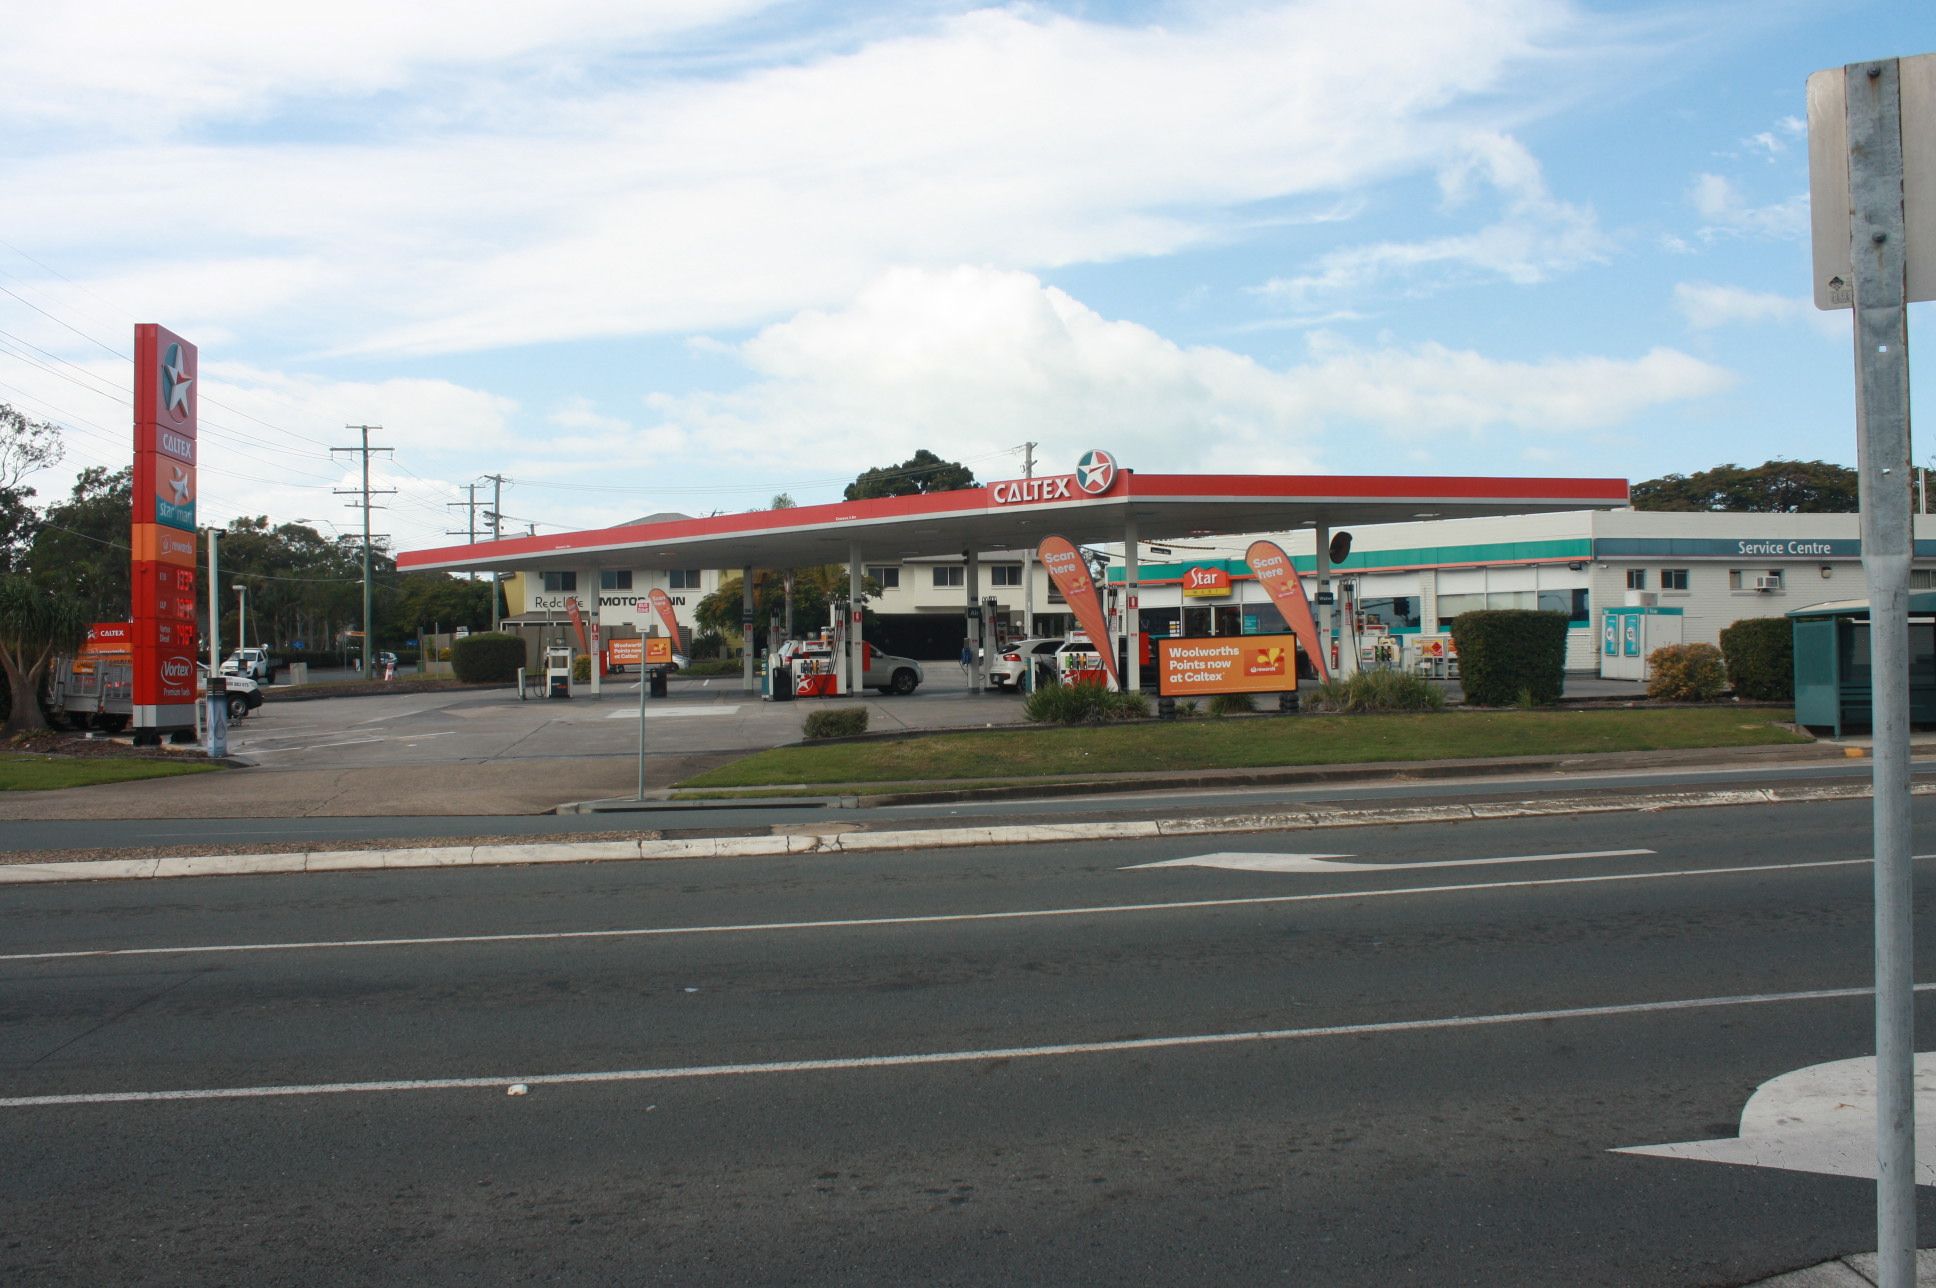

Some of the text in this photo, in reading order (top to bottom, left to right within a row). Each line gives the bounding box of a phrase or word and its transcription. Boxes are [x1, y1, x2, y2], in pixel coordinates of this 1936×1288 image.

[163, 433, 192, 459] CALTEX
[993, 478, 1071, 504] CALTEX
[160, 501, 174, 518] star
[1738, 541, 1831, 554] Service Centre
[1045, 551, 1076, 563] Scan
[1252, 556, 1283, 568] Scan
[1049, 563, 1076, 575] here
[1257, 567, 1284, 579] here
[1190, 567, 1218, 588] Star
[1168, 646, 1240, 658] Woolworths
[163, 661, 190, 677] Vortex
[1169, 659, 1232, 671] Points now
[1169, 671, 1223, 683] at Caltex
[163, 687, 180, 697] Premium
